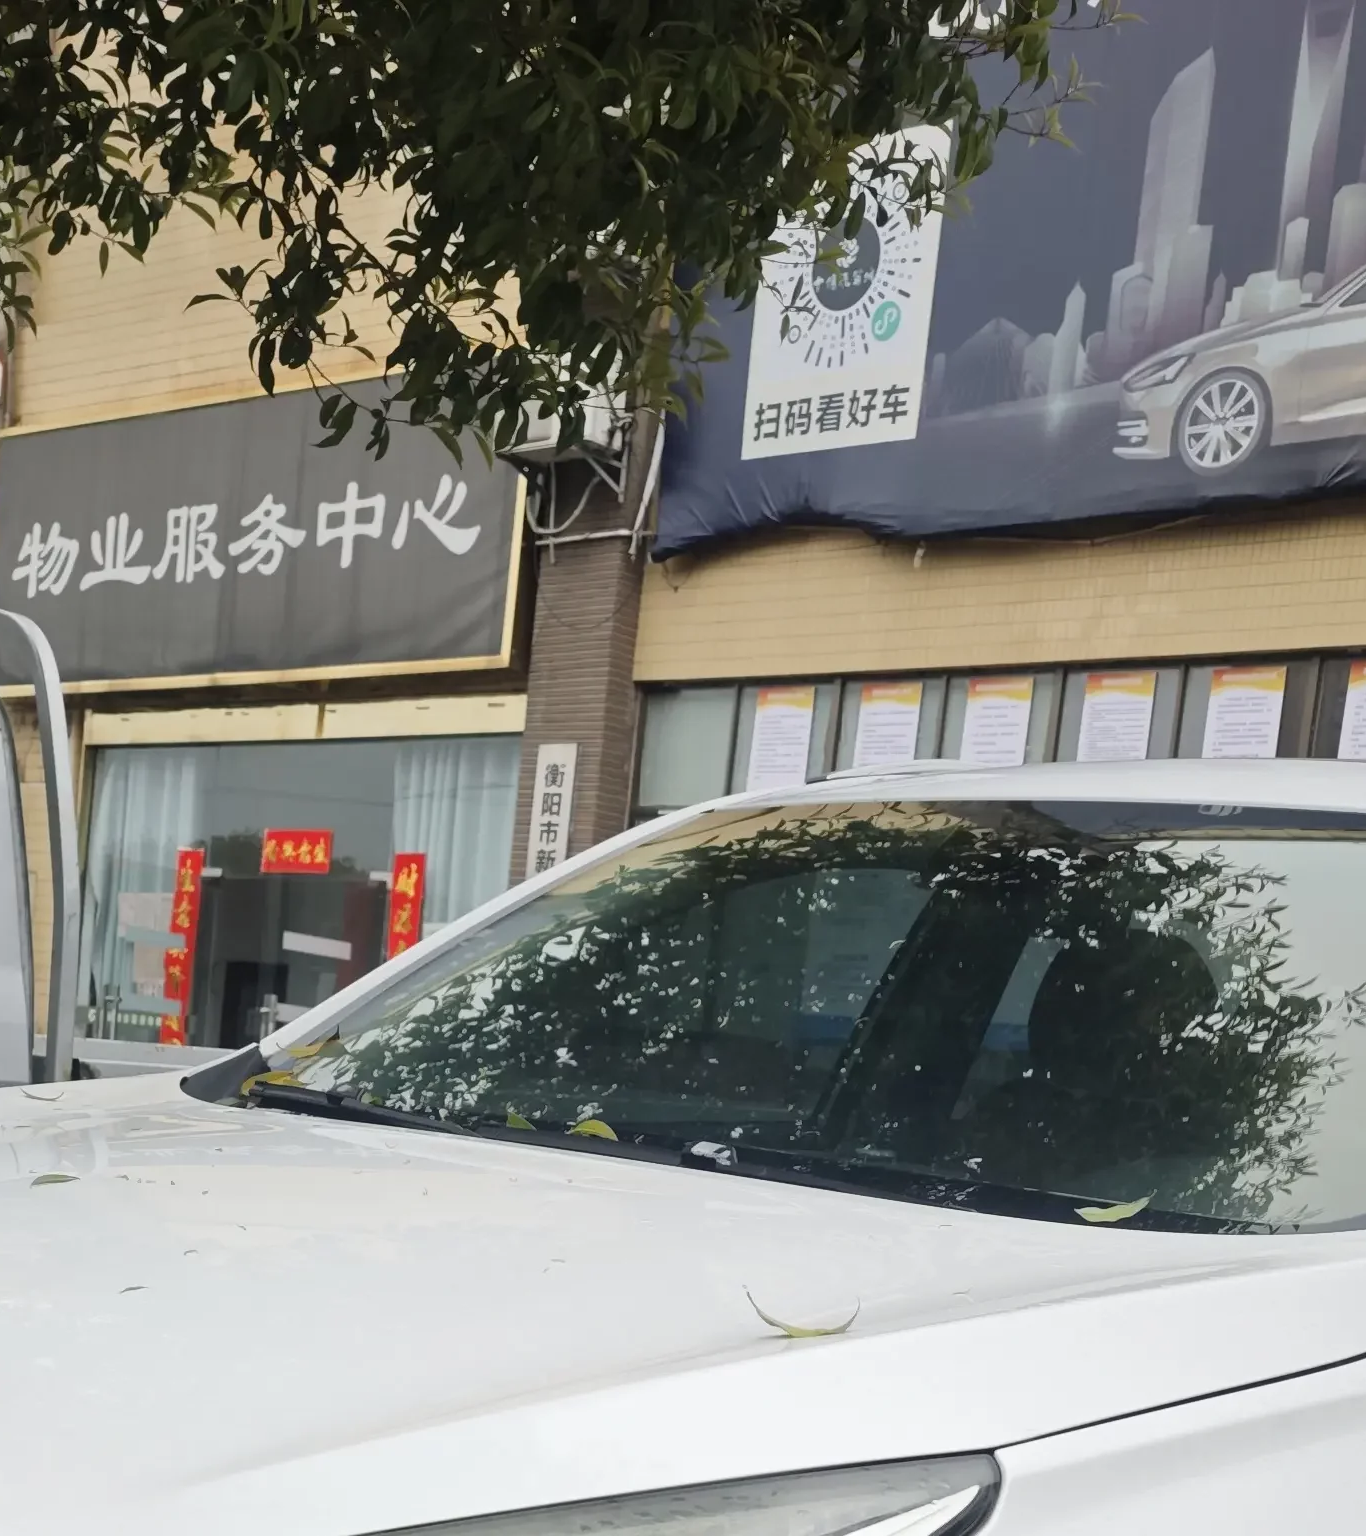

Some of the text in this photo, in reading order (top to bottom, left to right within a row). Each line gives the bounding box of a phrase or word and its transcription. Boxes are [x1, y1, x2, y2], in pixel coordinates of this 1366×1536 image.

[753, 384, 910, 441] 扫码看好车
[10, 473, 482, 600] 物业服务中心
